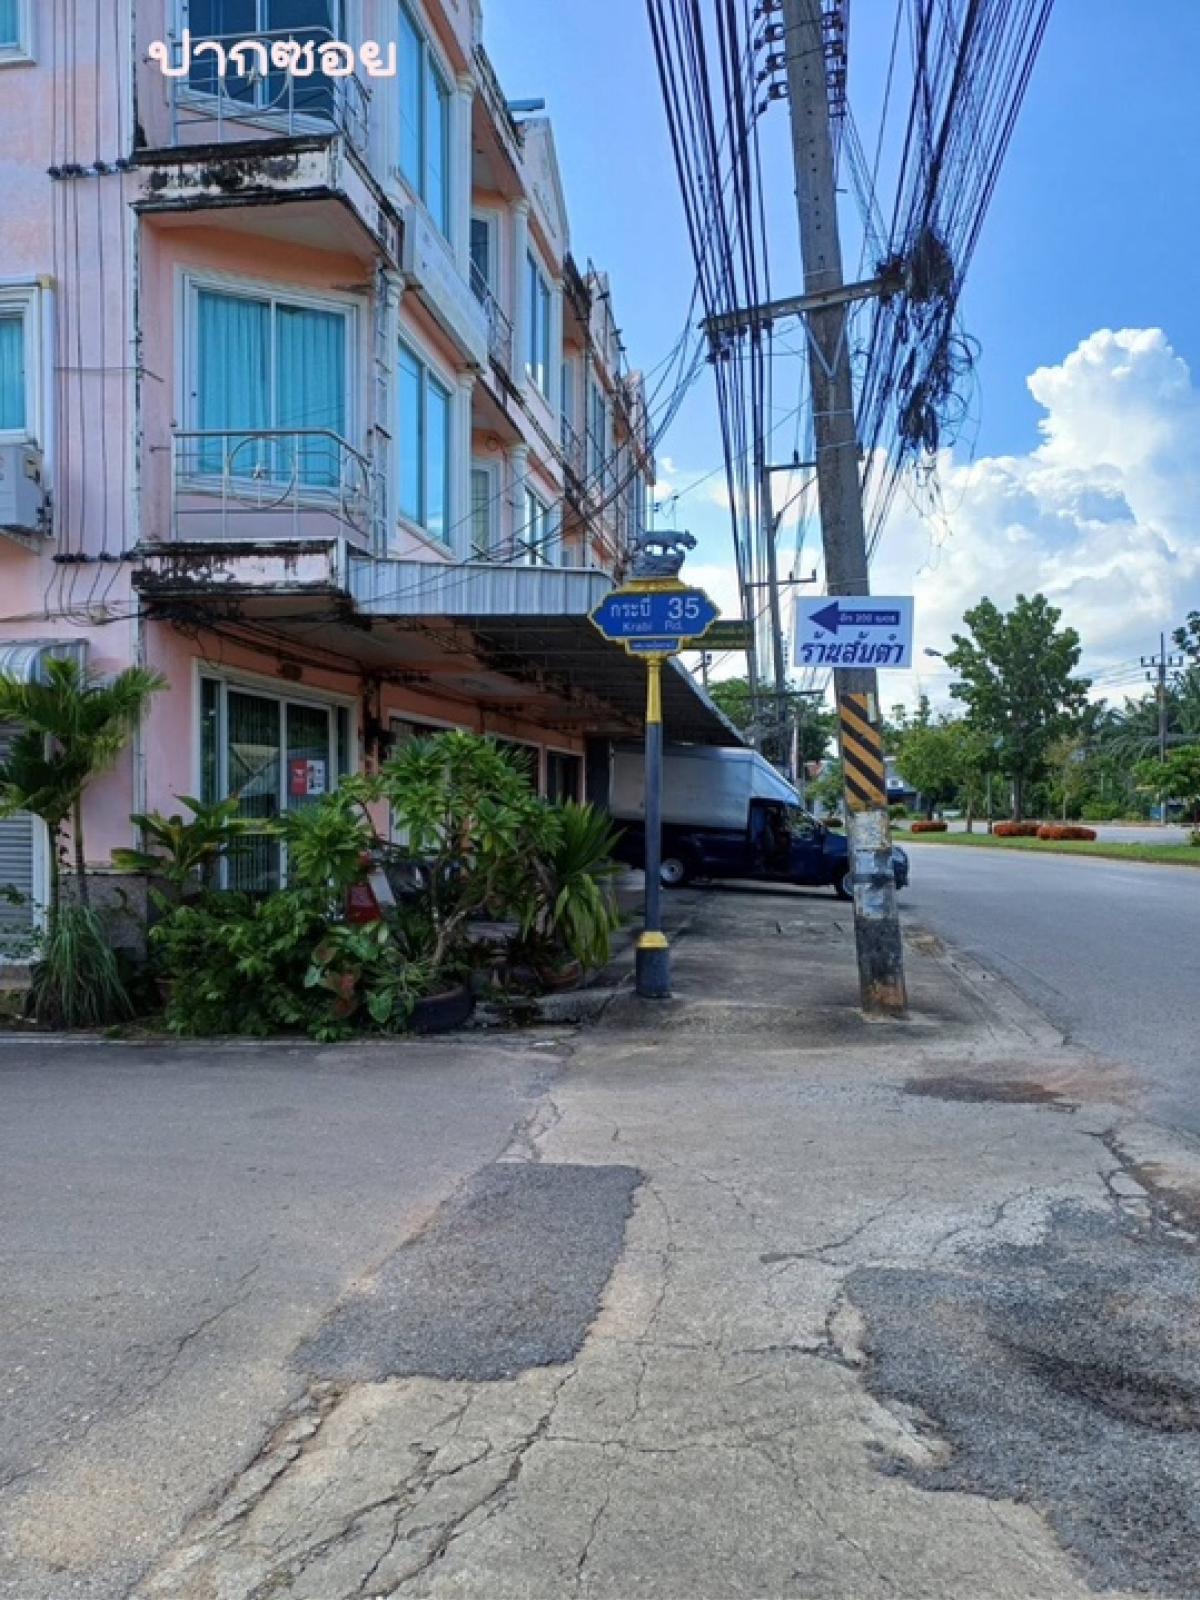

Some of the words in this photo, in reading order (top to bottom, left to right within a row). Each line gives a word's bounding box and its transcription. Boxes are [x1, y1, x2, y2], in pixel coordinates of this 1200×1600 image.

[668, 597, 699, 619] 35
[801, 630, 905, 663] ร้านส้มตำ
